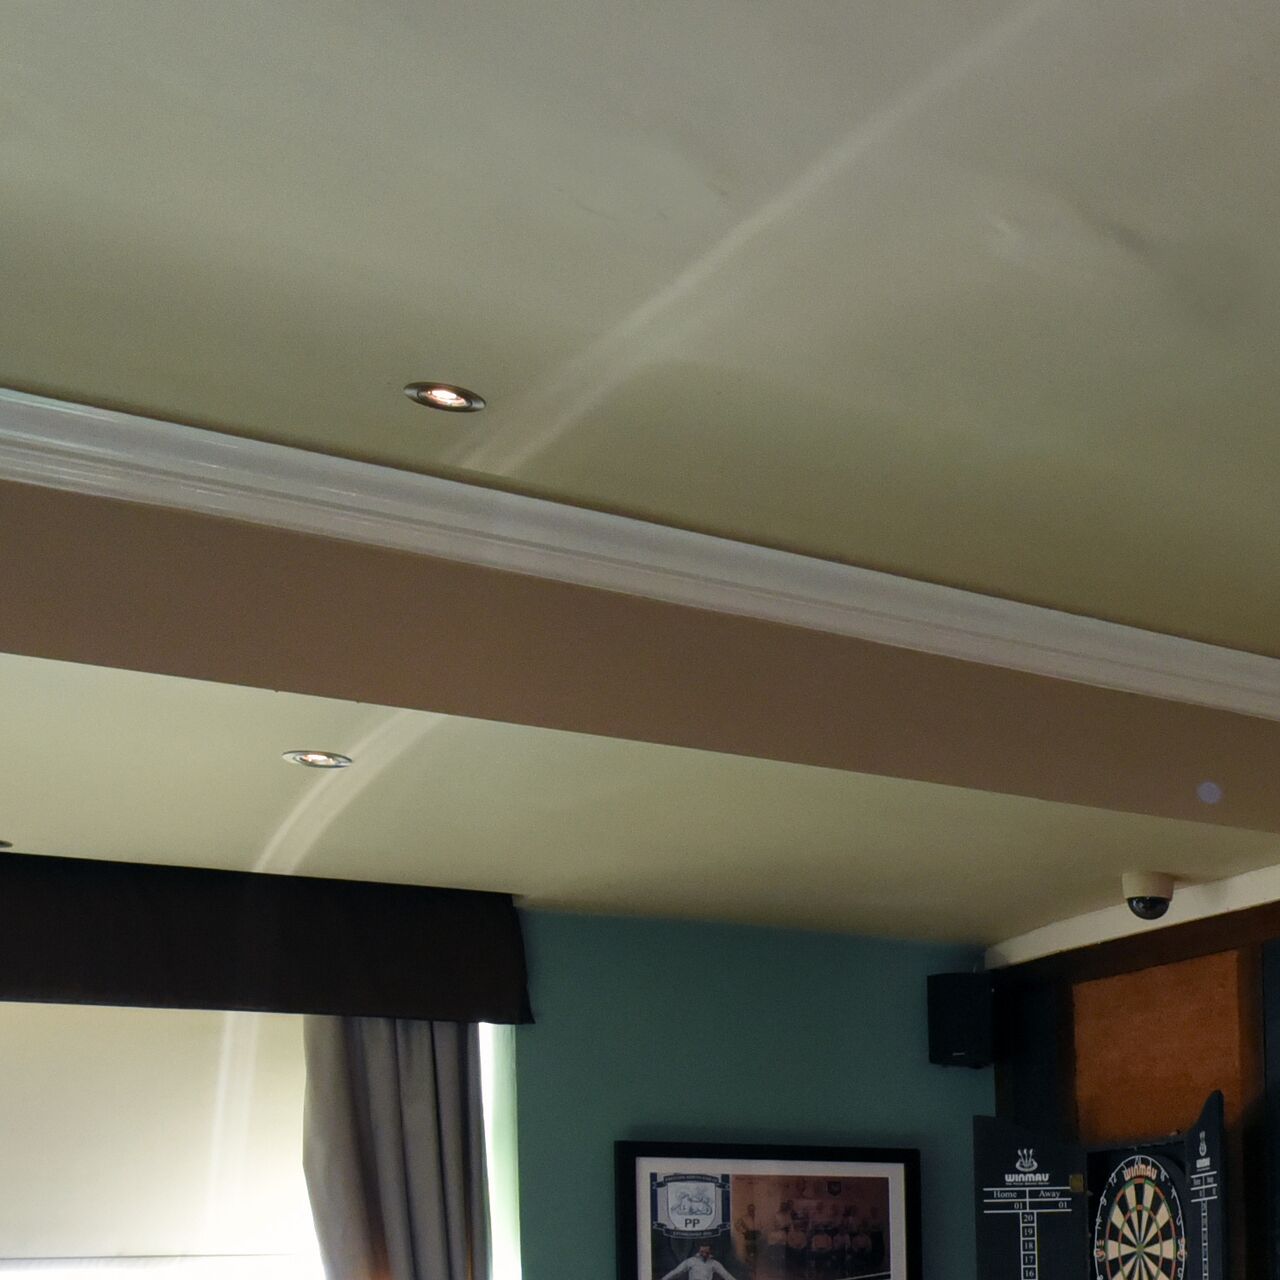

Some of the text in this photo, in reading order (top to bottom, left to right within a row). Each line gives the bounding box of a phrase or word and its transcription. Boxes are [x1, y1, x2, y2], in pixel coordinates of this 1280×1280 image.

[1004, 1172, 1050, 1182] WINMAU
[1123, 1165, 1157, 1181] WINMAU
[993, 1189, 1061, 1199] Home Away
[1023, 1214, 1033, 1222] 20
[1024, 1228, 1033, 1236] 19
[1024, 1241, 1034, 1249] 18
[1024, 1255, 1034, 1263] 17
[1025, 1269, 1035, 1277] 16
